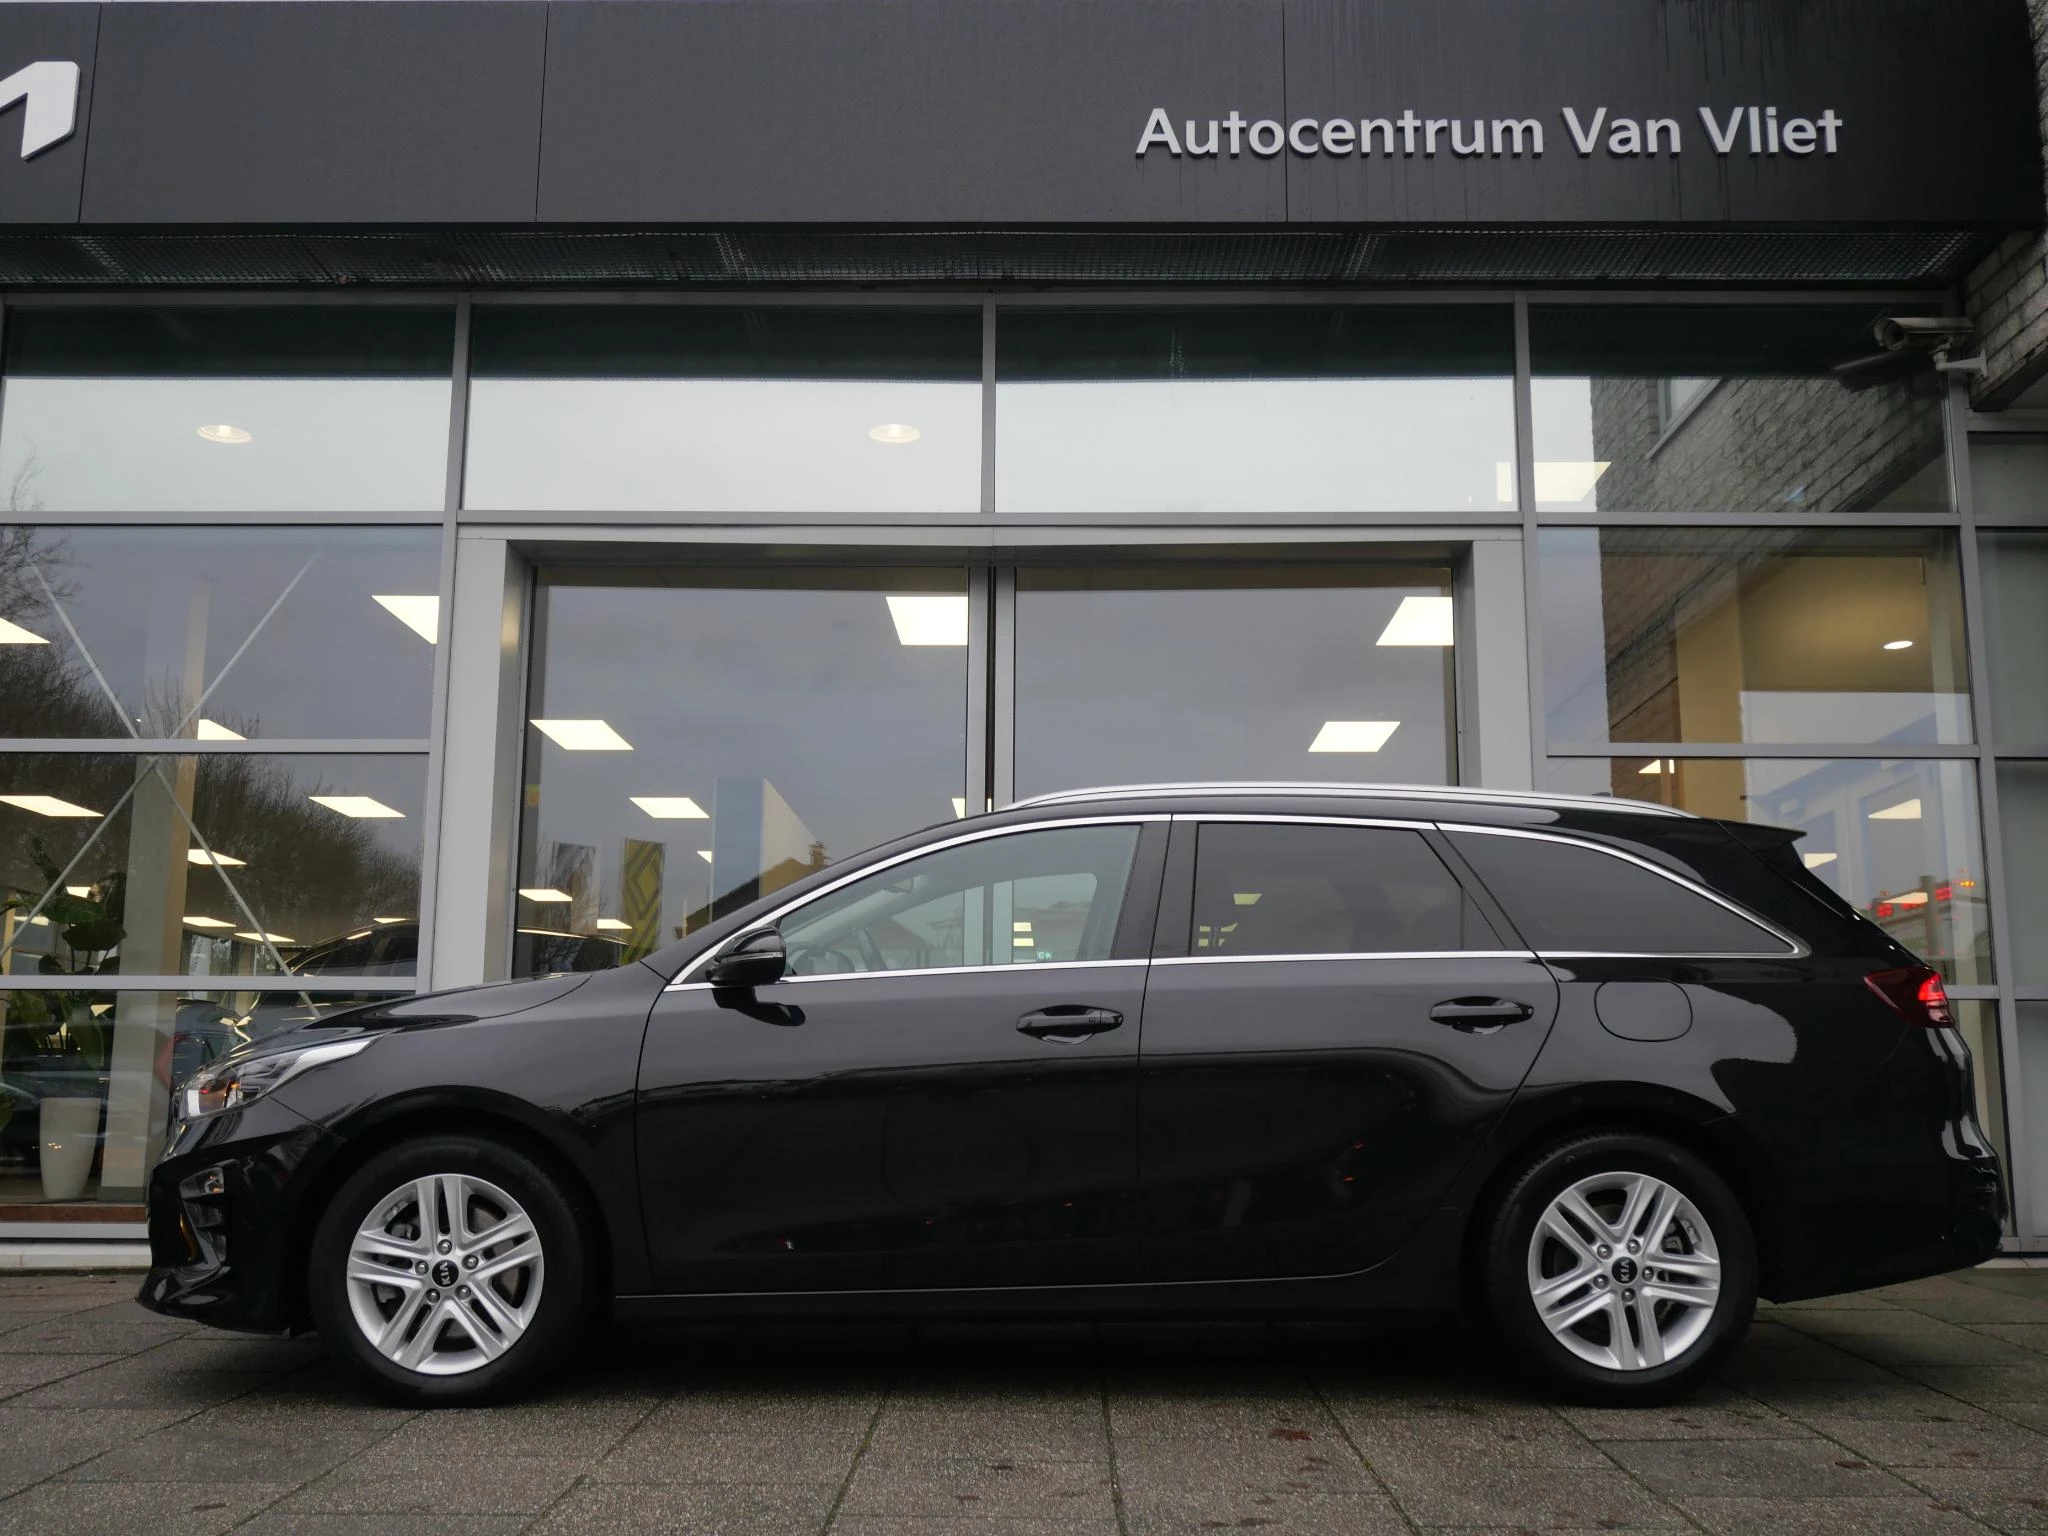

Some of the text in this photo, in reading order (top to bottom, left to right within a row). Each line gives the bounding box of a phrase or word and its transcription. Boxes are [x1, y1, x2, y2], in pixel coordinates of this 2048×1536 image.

[1135, 106, 1842, 155] Autocentrum Van Vliet
[439, 1262, 451, 1286] KIA
[1620, 1259, 1630, 1282] KIA
